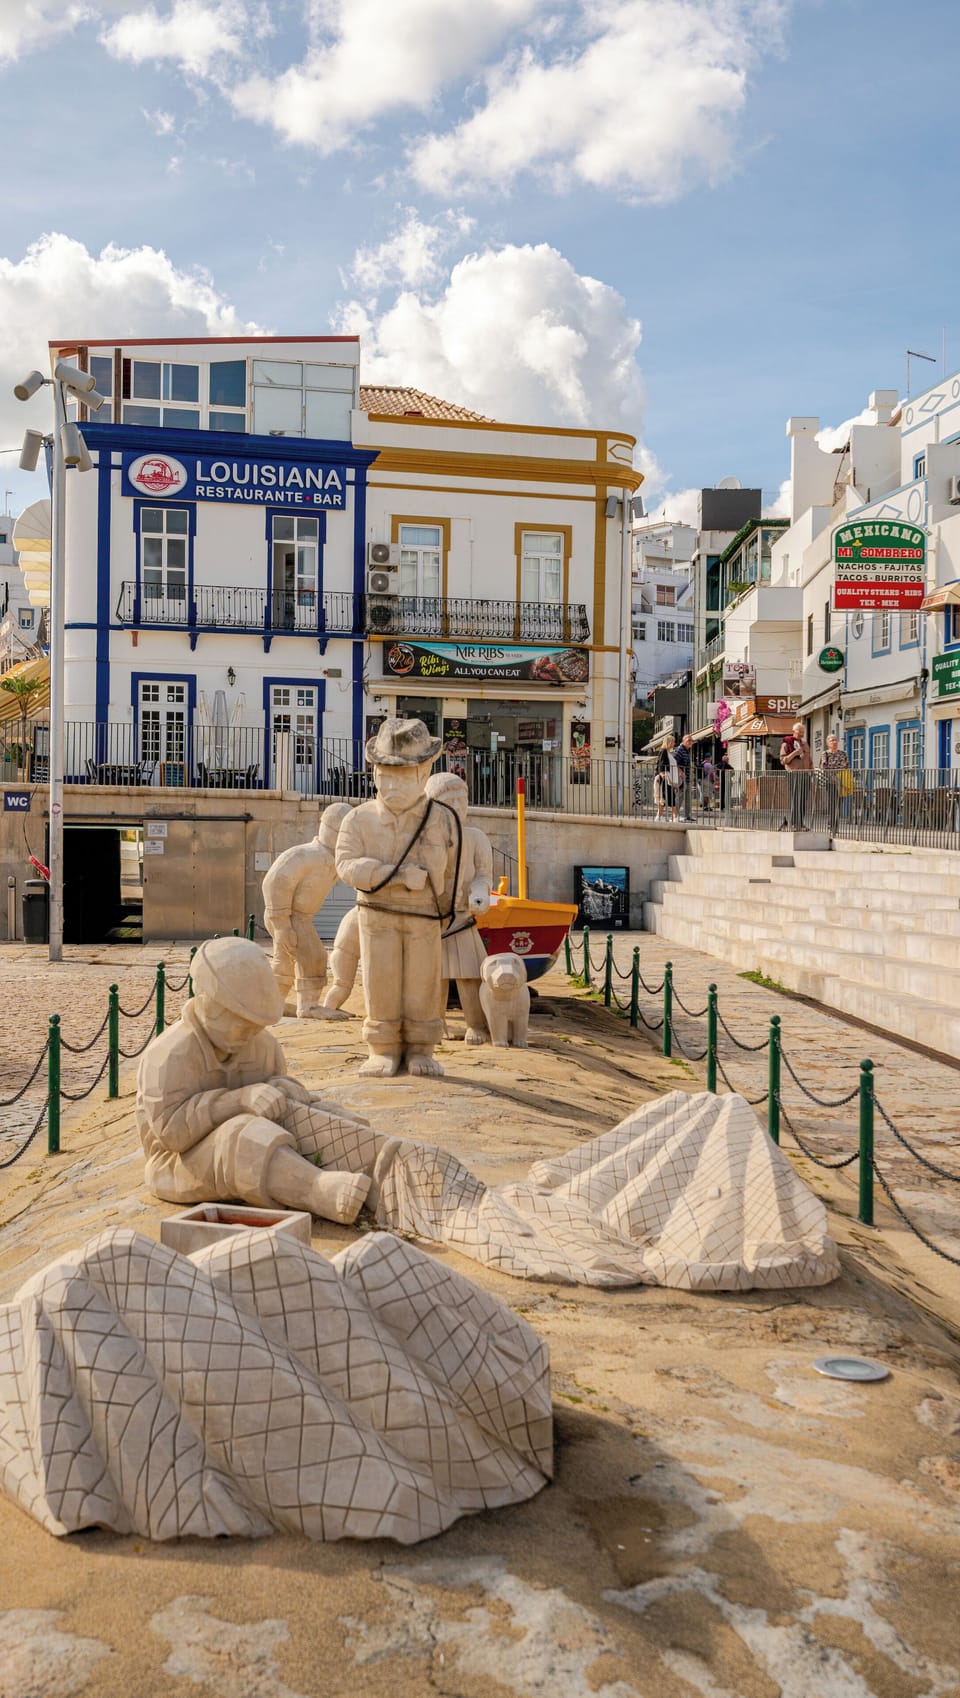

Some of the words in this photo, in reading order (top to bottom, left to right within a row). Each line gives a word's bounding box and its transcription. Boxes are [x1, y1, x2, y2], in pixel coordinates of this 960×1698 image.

[196, 460, 342, 490] LOUISIANA
[196, 485, 303, 502] RESTAURANTE
[313, 493, 342, 505] BAR
[839, 525, 921, 543] MEXICANO
[837, 547, 853, 558] MI
[861, 547, 922, 559] SOMBRERO
[837, 563, 877, 571] NACHOS
[884, 564, 922, 572] FAJITAS
[875, 575, 922, 583] BURRITOS
[836, 588, 870, 596] QUALITY
[456, 645, 475, 660] MR
[479, 647, 505, 660] RIBS
[420, 656, 439, 667] Ribs
[935, 659, 959, 672] QUALITY
[421, 664, 450, 676] Wings
[454, 667, 471, 675] ALL
[471, 668, 487, 676] YOU
[487, 668, 505, 676] CAN
[505, 669, 521, 677] EAT
[8, 797, 28, 807] WC
